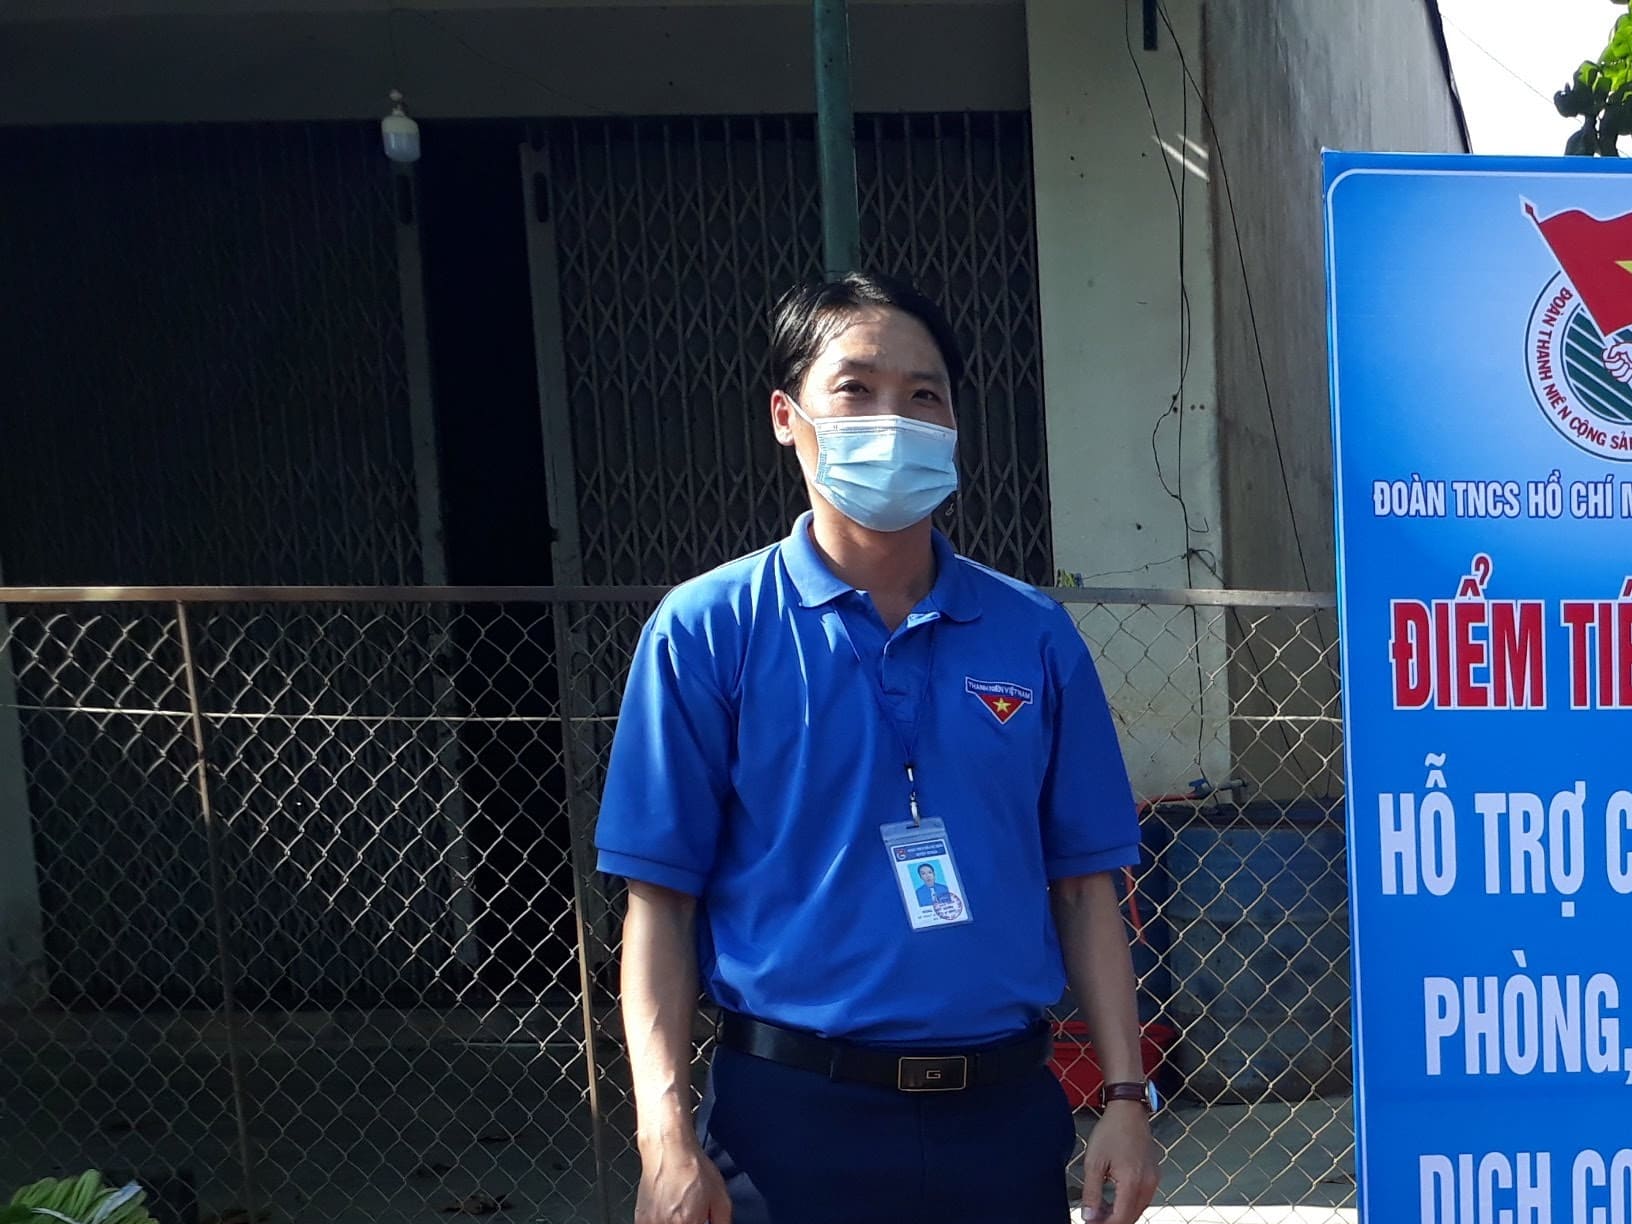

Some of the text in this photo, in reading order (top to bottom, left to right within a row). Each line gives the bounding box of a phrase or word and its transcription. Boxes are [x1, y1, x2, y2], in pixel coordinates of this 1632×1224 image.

[1542, 287, 1573, 327] ĐOÀN
[1536, 329, 1553, 381] THANH
[1569, 416, 1605, 446] CỘNG
[1373, 473, 1445, 518] ĐOÀN
[1453, 481, 1519, 518] TNCS
[1528, 469, 1563, 518] HỒ
[1571, 473, 1615, 518] CHÍ
[1389, 553, 1546, 711] ĐIỂM
[1378, 753, 1457, 897] HỖ
[1474, 781, 1587, 918] TRỢ
